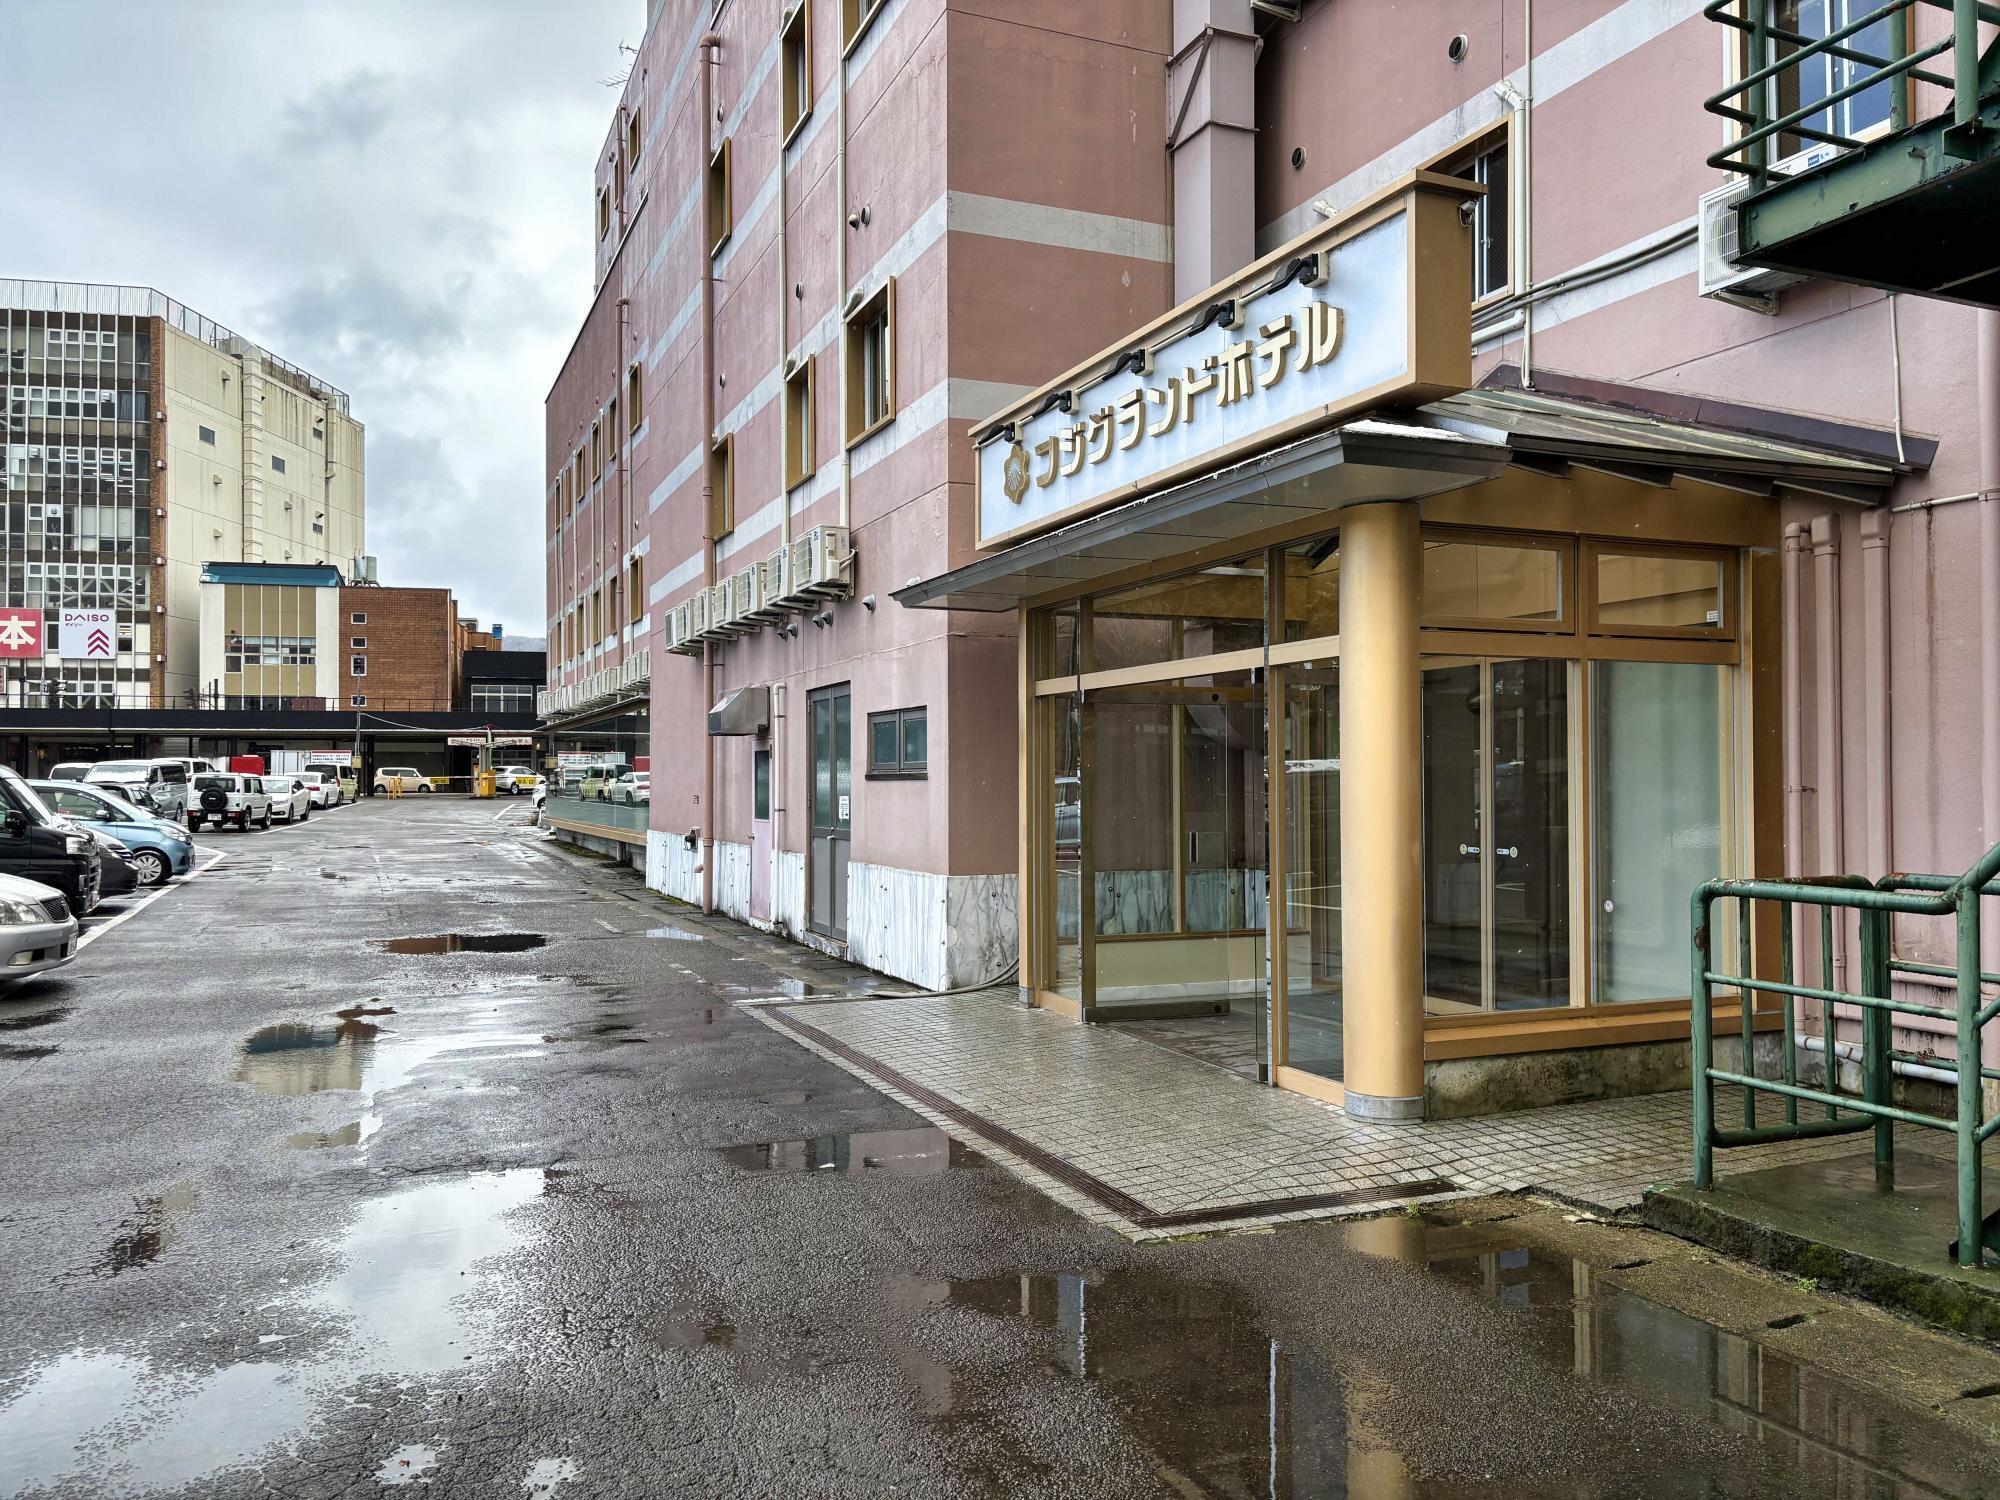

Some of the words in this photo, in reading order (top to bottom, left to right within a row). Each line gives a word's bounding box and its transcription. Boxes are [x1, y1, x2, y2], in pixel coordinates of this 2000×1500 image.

[1035, 301, 1344, 487] フジグランドホテル
[0, 615, 37, 650] 本
[64, 613, 110, 622] DAISO
